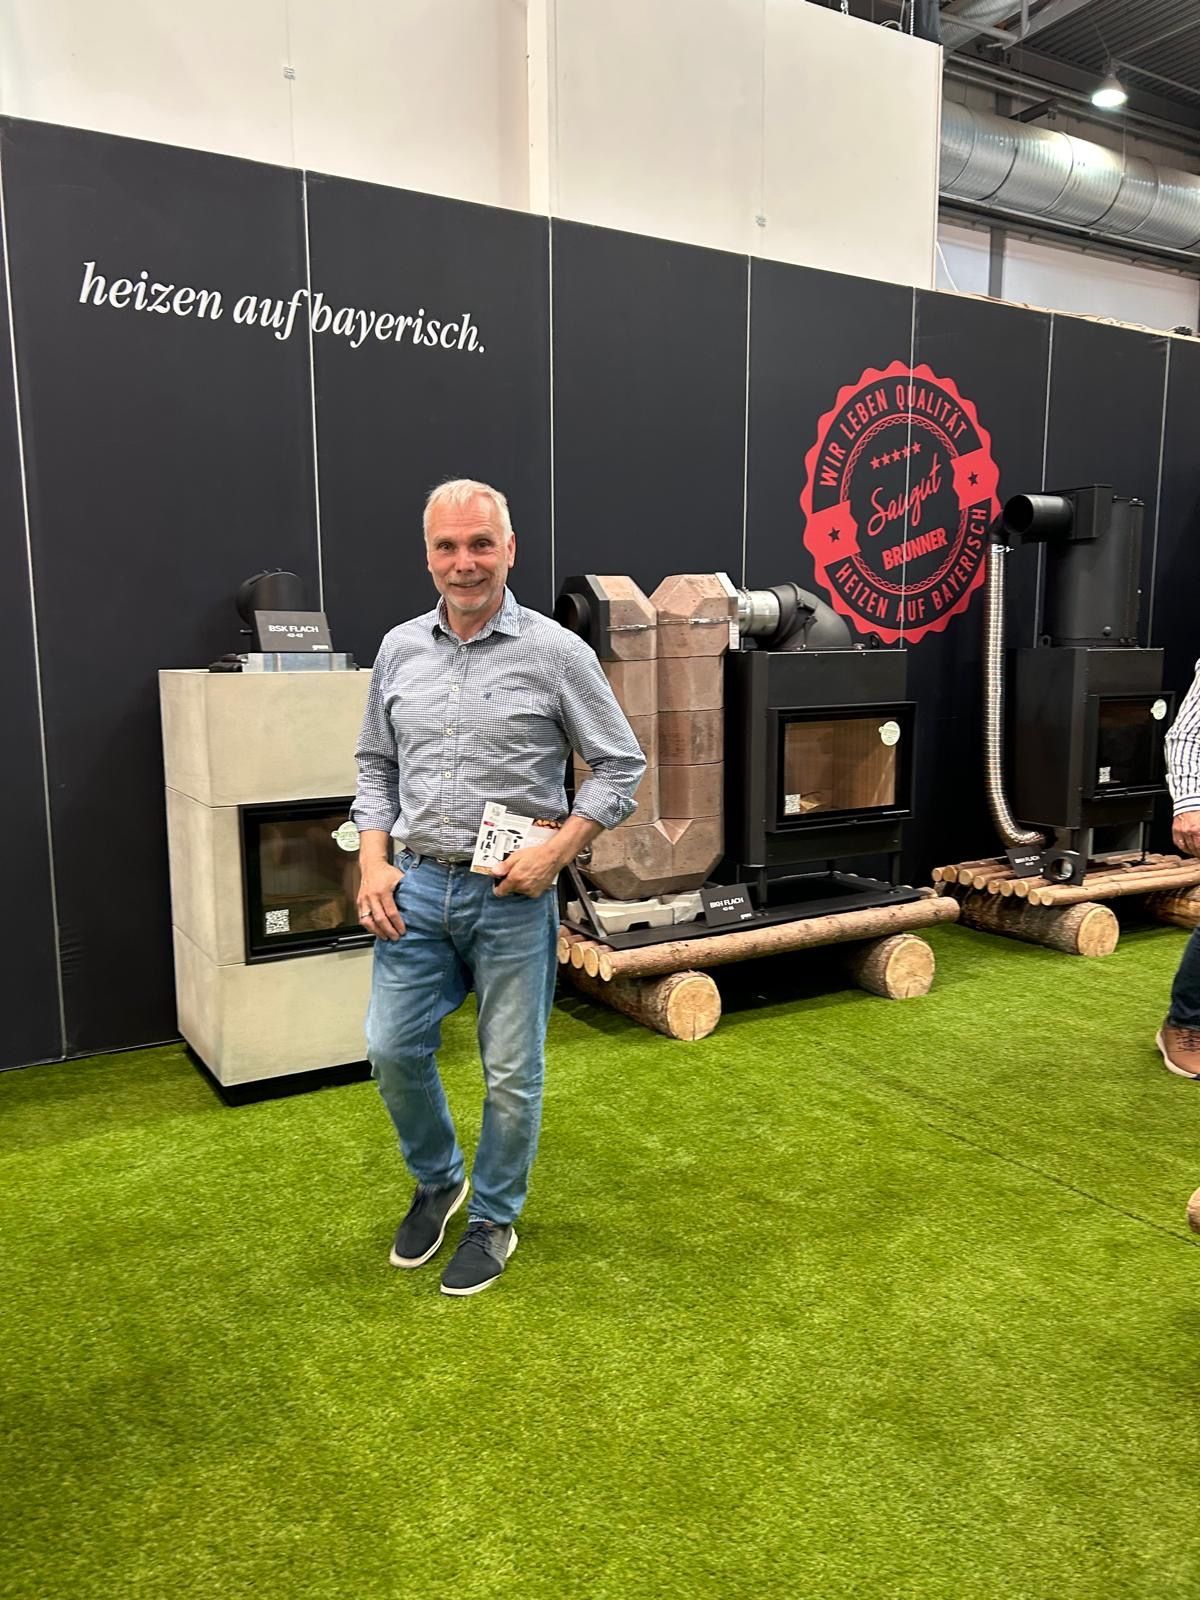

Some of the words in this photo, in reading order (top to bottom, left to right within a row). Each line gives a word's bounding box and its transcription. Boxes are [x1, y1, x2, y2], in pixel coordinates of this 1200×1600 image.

[79, 261, 223, 320] heizen
[232, 288, 309, 341] auf
[311, 292, 486, 353] bayerisch.
[820, 441, 847, 487] WIR
[839, 388, 889, 440] LEBEN
[896, 384, 967, 439] QUALITÄT
[867, 452, 943, 536] Saugut
[835, 562, 888, 619] HEIZEN
[896, 600, 926, 622] AUF
[932, 508, 987, 609] BAYERISCH
[881, 527, 949, 570] BRUNNER
[289, 625, 319, 633] FLACH
